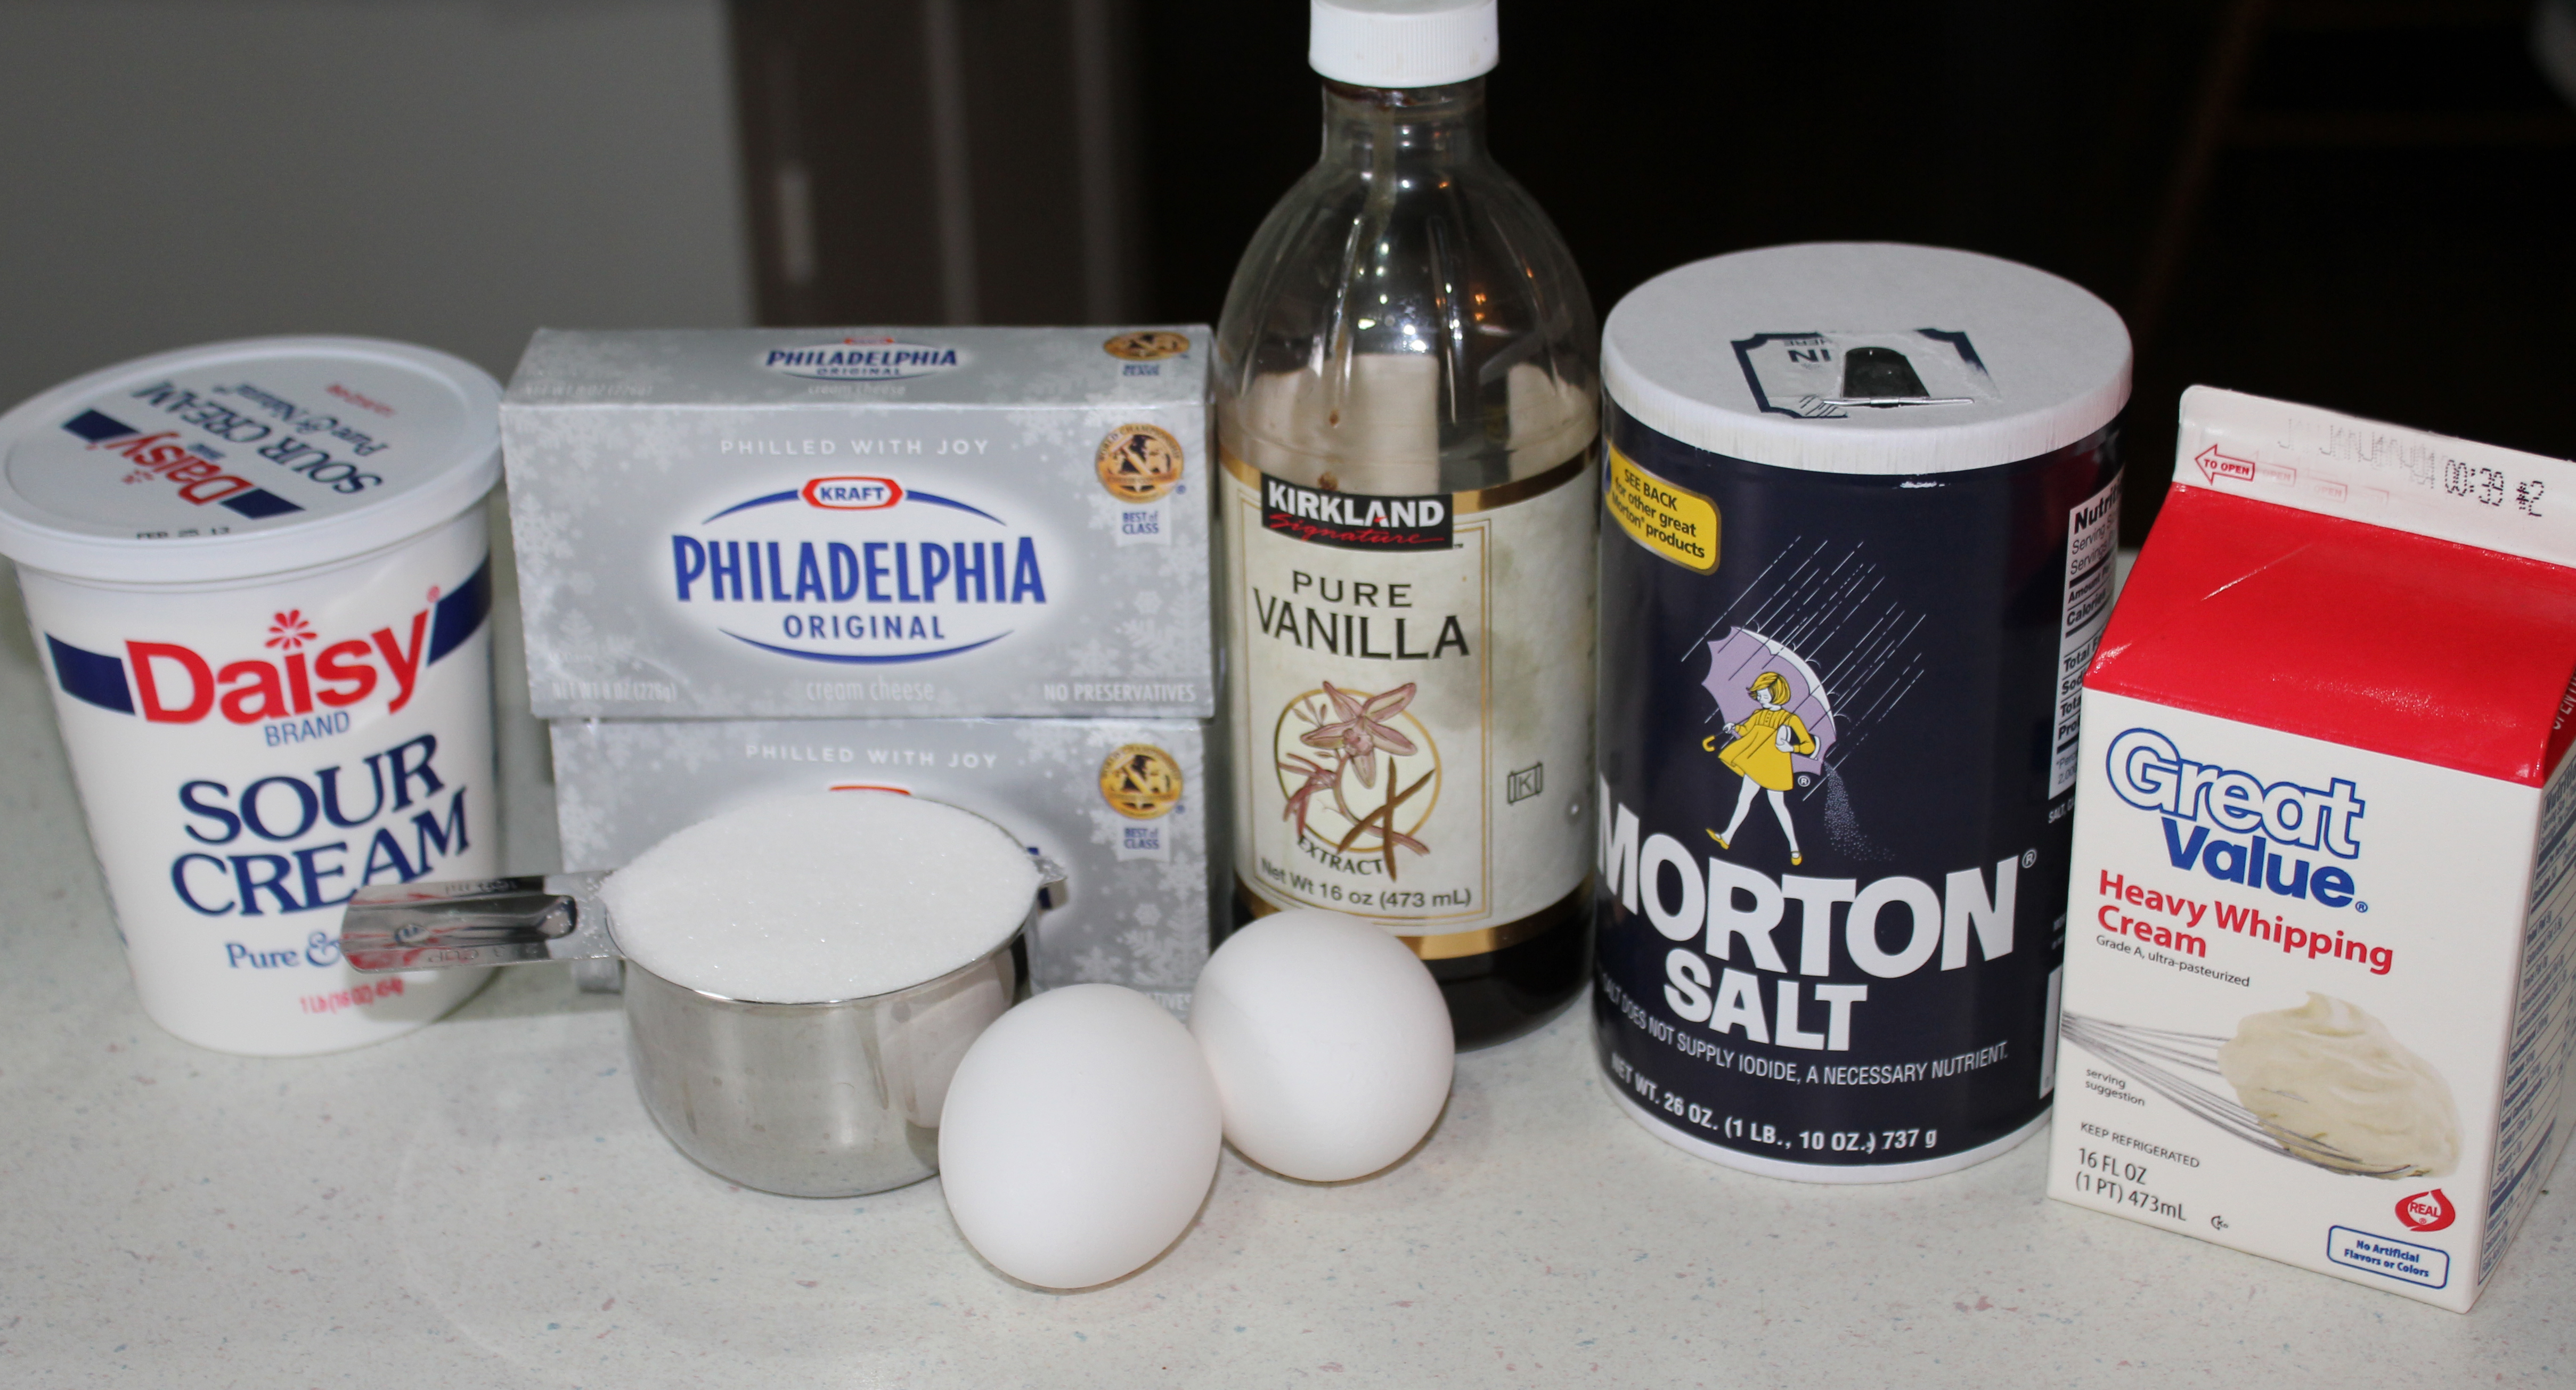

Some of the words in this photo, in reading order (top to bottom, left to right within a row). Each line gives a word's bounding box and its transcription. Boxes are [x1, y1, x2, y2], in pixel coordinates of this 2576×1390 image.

[766, 349, 957, 366] PHILADELPHIA
[1787, 348, 1831, 363] IN
[131, 381, 271, 443] CREAM
[259, 435, 384, 494] SOUR
[721, 440, 836, 455] PHILLED
[851, 439, 922, 455] WITH
[938, 439, 989, 455] JOY
[2203, 458, 2217, 469] TO
[2220, 463, 2249, 475] OPEN
[104, 431, 255, 506] Daisy
[820, 487, 885, 501] KRAFT
[1268, 481, 1445, 528] KIRKLAND
[1624, 469, 1641, 492] SEE
[1643, 483, 1678, 512] BACK
[1122, 512, 1147, 522] BEST
[1122, 523, 1159, 534] CLASS
[1267, 513, 1445, 544] Signature
[1628, 493, 1657, 518] other
[1659, 512, 1697, 538] great
[1645, 523, 1705, 559] products
[2072, 523, 2106, 555] Serving
[672, 535, 1047, 604] PHILADELPHIA
[1292, 570, 1413, 609] PURE
[783, 615, 945, 640] ORIGINAL
[1252, 586, 1470, 661] VANILLA
[125, 609, 429, 724] Daisy
[2064, 642, 2090, 672] Total
[805, 681, 864, 701] cream
[869, 676, 935, 701] cheese
[1044, 684, 1069, 701] NO
[1074, 683, 1196, 702] PRESERVATIVES
[264, 711, 350, 747] BRAND
[747, 745, 854, 763] PHILLED
[866, 750, 934, 766] WITH
[948, 752, 997, 768] JOY
[178, 733, 445, 845] SOUR
[2106, 727, 2366, 859] Great
[170, 786, 470, 917] CREAM
[1123, 838, 1159, 849] CLASS
[1297, 835, 1384, 876] EXTRACT
[2161, 816, 2355, 908] Value
[1260, 857, 1286, 884] Net
[1289, 871, 1314, 895] Wt
[1319, 884, 1343, 901] 16
[1348, 892, 1373, 906] oz
[1379, 890, 1425, 909] (473
[1432, 887, 1471, 907] mL)
[1599, 772, 2019, 978] MORTON
[2098, 869, 2207, 928] Heavy
[2213, 900, 2394, 975] Whipping
[2098, 904, 2206, 958] Cream
[225, 941, 300, 969] Pure
[305, 931, 341, 967] &
[2096, 934, 2131, 954] Grade
[2134, 946, 2145, 959] A,
[2148, 951, 2251, 987] ultra-pasteurized
[1664, 947, 1868, 1051] SALT
[1621, 993, 1647, 1029] DOES
[1648, 1015, 1675, 1045] NOT
[1677, 1032, 1736, 1069] SUPPLY
[1738, 1053, 1802, 1085] IODIDE,
[1805, 1066, 1819, 1084] A
[1823, 1062, 1928, 1085] NECESSARY
[1931, 1040, 2009, 1079] NUTRIENT.
[2084, 1080, 2146, 1107] suggestion
[2085, 1068, 2126, 1090] serving
[1611, 1052, 1633, 1084] NET
[1634, 1070, 1660, 1104] WT.
[1663, 1091, 1685, 1116] 26
[1688, 1102, 1718, 1130] OZ.
[1724, 1116, 1743, 1139] (1
[1750, 1122, 1792, 1150] LB.,
[1799, 1131, 1825, 1151] 10
[1830, 1131, 1876, 1155] OZ.)
[1882, 1127, 1920, 1150] 737
[1925, 1129, 1937, 1148] g
[2080, 1122, 2109, 1139] KEEP
[2112, 1132, 2200, 1168] REFRIGERATED
[2078, 1148, 2098, 1168] 16
[2101, 1155, 2120, 1177] FL
[2124, 1163, 2147, 1185] OZ
[2075, 1171, 2091, 1192] (1
[2096, 1178, 2123, 1204] PT)
[2128, 1190, 2186, 1221] 473mL
[2409, 1201, 2441, 1218] REAL
[2344, 1248, 2381, 1266] Flavors
[2383, 1259, 2395, 1269] or
[2397, 1262, 2429, 1278] Colors
[2356, 1240, 2370, 1252] No
[2372, 1244, 2420, 1263] Artificial
